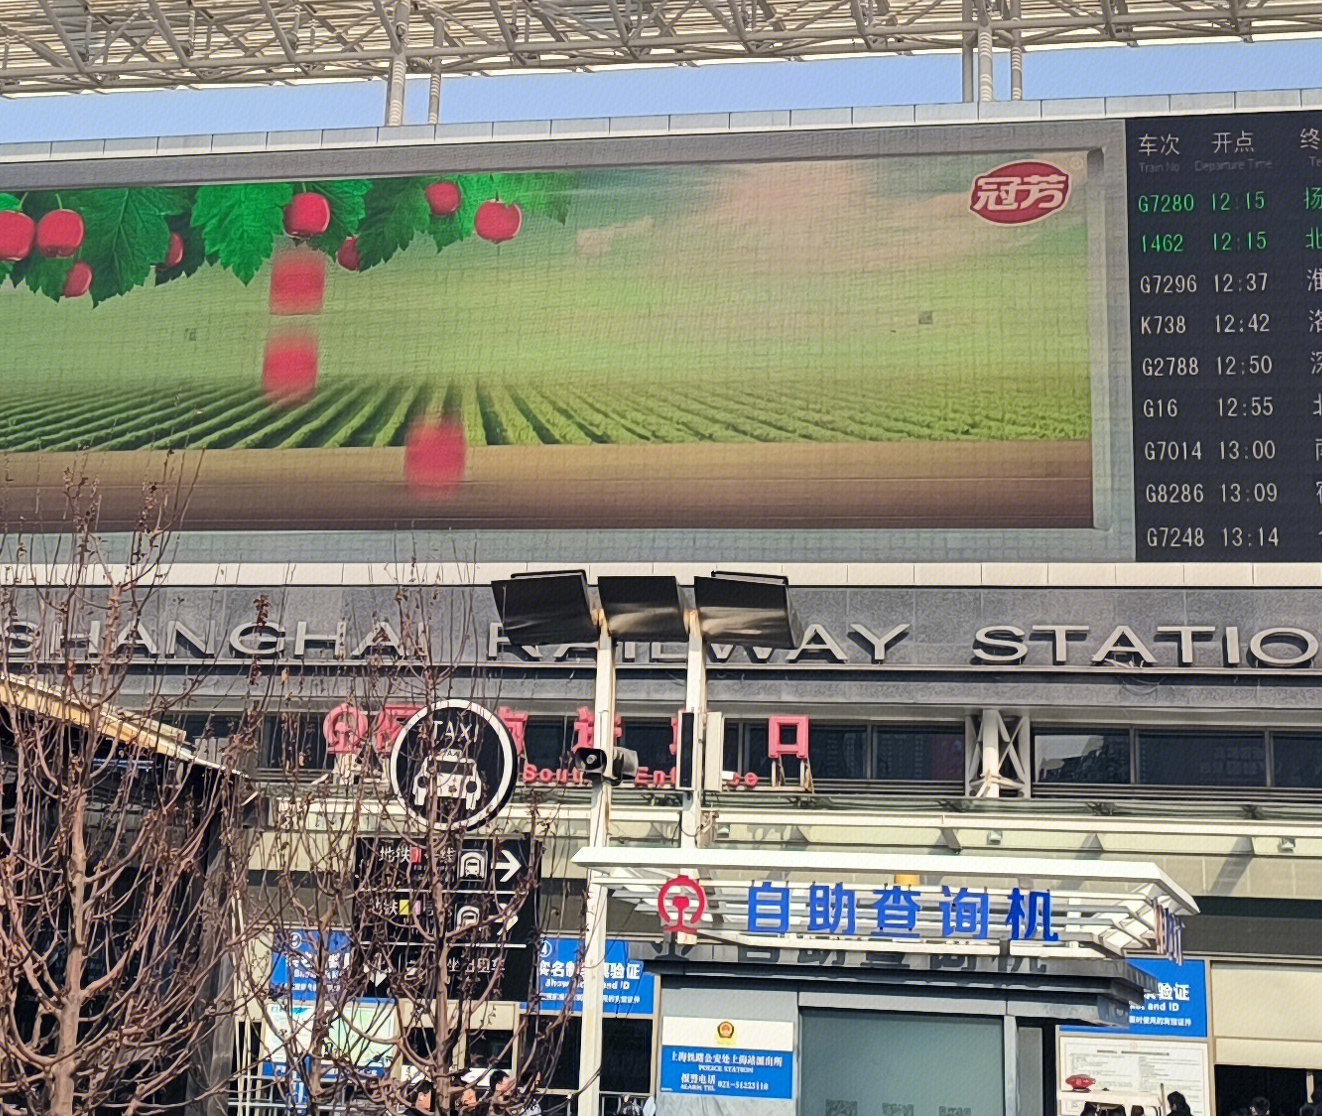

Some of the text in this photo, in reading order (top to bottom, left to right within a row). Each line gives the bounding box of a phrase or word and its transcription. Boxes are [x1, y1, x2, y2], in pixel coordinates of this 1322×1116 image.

[1139, 133, 1180, 156] 车次
[1211, 130, 1255, 153] 开点
[973, 174, 1067, 211] 冠芳
[1139, 194, 1194, 212] G7280
[1212, 191, 1265, 211] 12:15
[1142, 234, 1184, 252] 1462
[1213, 232, 1267, 251] 12:15
[1140, 275, 1197, 293] G7296
[1214, 273, 1268, 292] 12:37
[1141, 316, 1186, 334] K738
[1215, 313, 1270, 333] 12:42
[1142, 357, 1199, 376] G2788
[1217, 355, 1273, 375] 12:50
[1143, 398, 1177, 418] G16
[1218, 397, 1274, 417] 12:55
[1144, 441, 1202, 461] G7014
[1220, 440, 1276, 460] 13:00
[1146, 484, 1204, 503] G8286
[1221, 483, 1277, 503] 13:09
[1147, 527, 1205, 547] G7248
[1223, 527, 1279, 547] 13:14
[0, 621, 429, 658] SHANGHAI
[432, 720, 479, 743] TAXI
[523, 763, 592, 786] Sout
[748, 881, 1059, 942] 自助查询机
[539, 960, 641, 980] 实名制验证
[1148, 1002, 1166, 1011] and
[1169, 1003, 1180, 1011] ID
